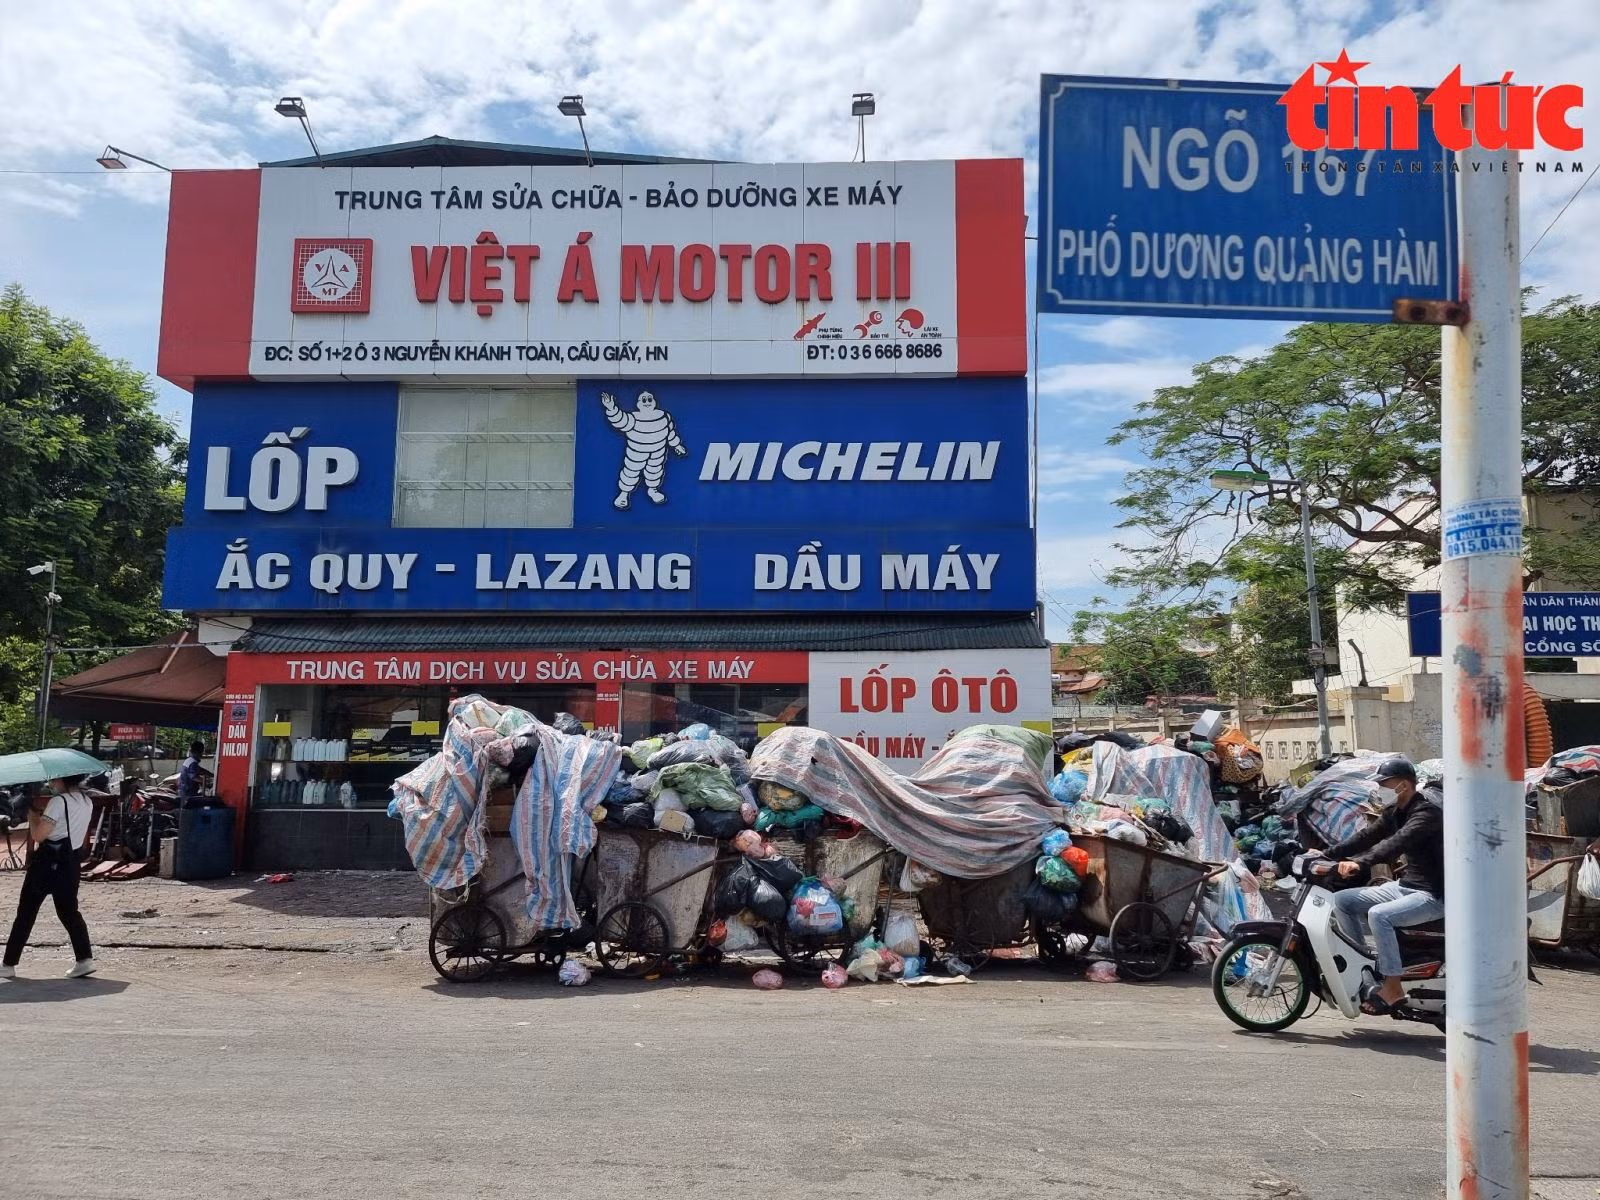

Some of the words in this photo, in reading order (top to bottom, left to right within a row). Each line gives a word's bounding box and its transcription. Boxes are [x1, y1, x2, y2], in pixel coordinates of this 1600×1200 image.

[1122, 109, 1260, 193] NGÕ
[335, 190, 422, 210] TRUNG
[431, 186, 482, 209] TÂM
[492, 182, 543, 209] SỬA
[551, 184, 622, 209] CHỮA
[645, 181, 699, 208] BẢO
[707, 182, 797, 208] DƯỠNG
[806, 186, 838, 206] XE
[848, 180, 903, 206] MÁY
[1058, 214, 1121, 277] PHỐ
[1130, 231, 1244, 280] DƯƠNG
[1254, 223, 1362, 285] QUẢNG
[1373, 227, 1438, 286] HÀM
[410, 231, 540, 316] VIỆT
[557, 231, 600, 303] Á
[620, 243, 833, 304] MOTOR
[856, 242, 911, 301] III
[322, 287, 339, 296] MT
[264, 346, 293, 361] ĐC:
[298, 341, 324, 361] SỐ
[325, 346, 352, 361] 1+2
[355, 342, 368, 361] Ô
[371, 346, 381, 361] 3
[384, 339, 450, 361] NGUYỄN
[454, 342, 511, 361] KHÁNH
[515, 342, 565, 364] TOÀN,
[567, 340, 600, 361] CẦU
[603, 341, 641, 364] GIẤY,
[645, 346, 668, 361] HN
[807, 344, 835, 360] ĐT:
[204, 427, 360, 512] LỐP
[699, 440, 1001, 480] MICHELIN
[215, 538, 290, 590] ẮC
[309, 552, 419, 594] QUY
[475, 553, 691, 590] LAZANG
[754, 540, 861, 590] DẦU
[881, 544, 1000, 590] MÁY
[1540, 595, 1564, 606] DÂN
[1568, 595, 1600, 606] THÀN
[1543, 615, 1577, 635] HỌC
[1525, 636, 1576, 652] CỔNG
[287, 660, 364, 679] TRUNG
[374, 656, 420, 679] TÂM
[429, 661, 484, 683] DỊCH
[494, 660, 526, 683] VỤ
[536, 653, 582, 679] SỬA
[593, 654, 657, 679] CHỮA
[668, 660, 698, 679] XE
[708, 656, 754, 679] MÁY
[840, 663, 917, 713] LỐP
[931, 668, 1018, 713] ÔTÔ
[228, 722, 246, 738] DÁN
[886, 732, 926, 758] MÁY
[223, 742, 248, 756] NILON
